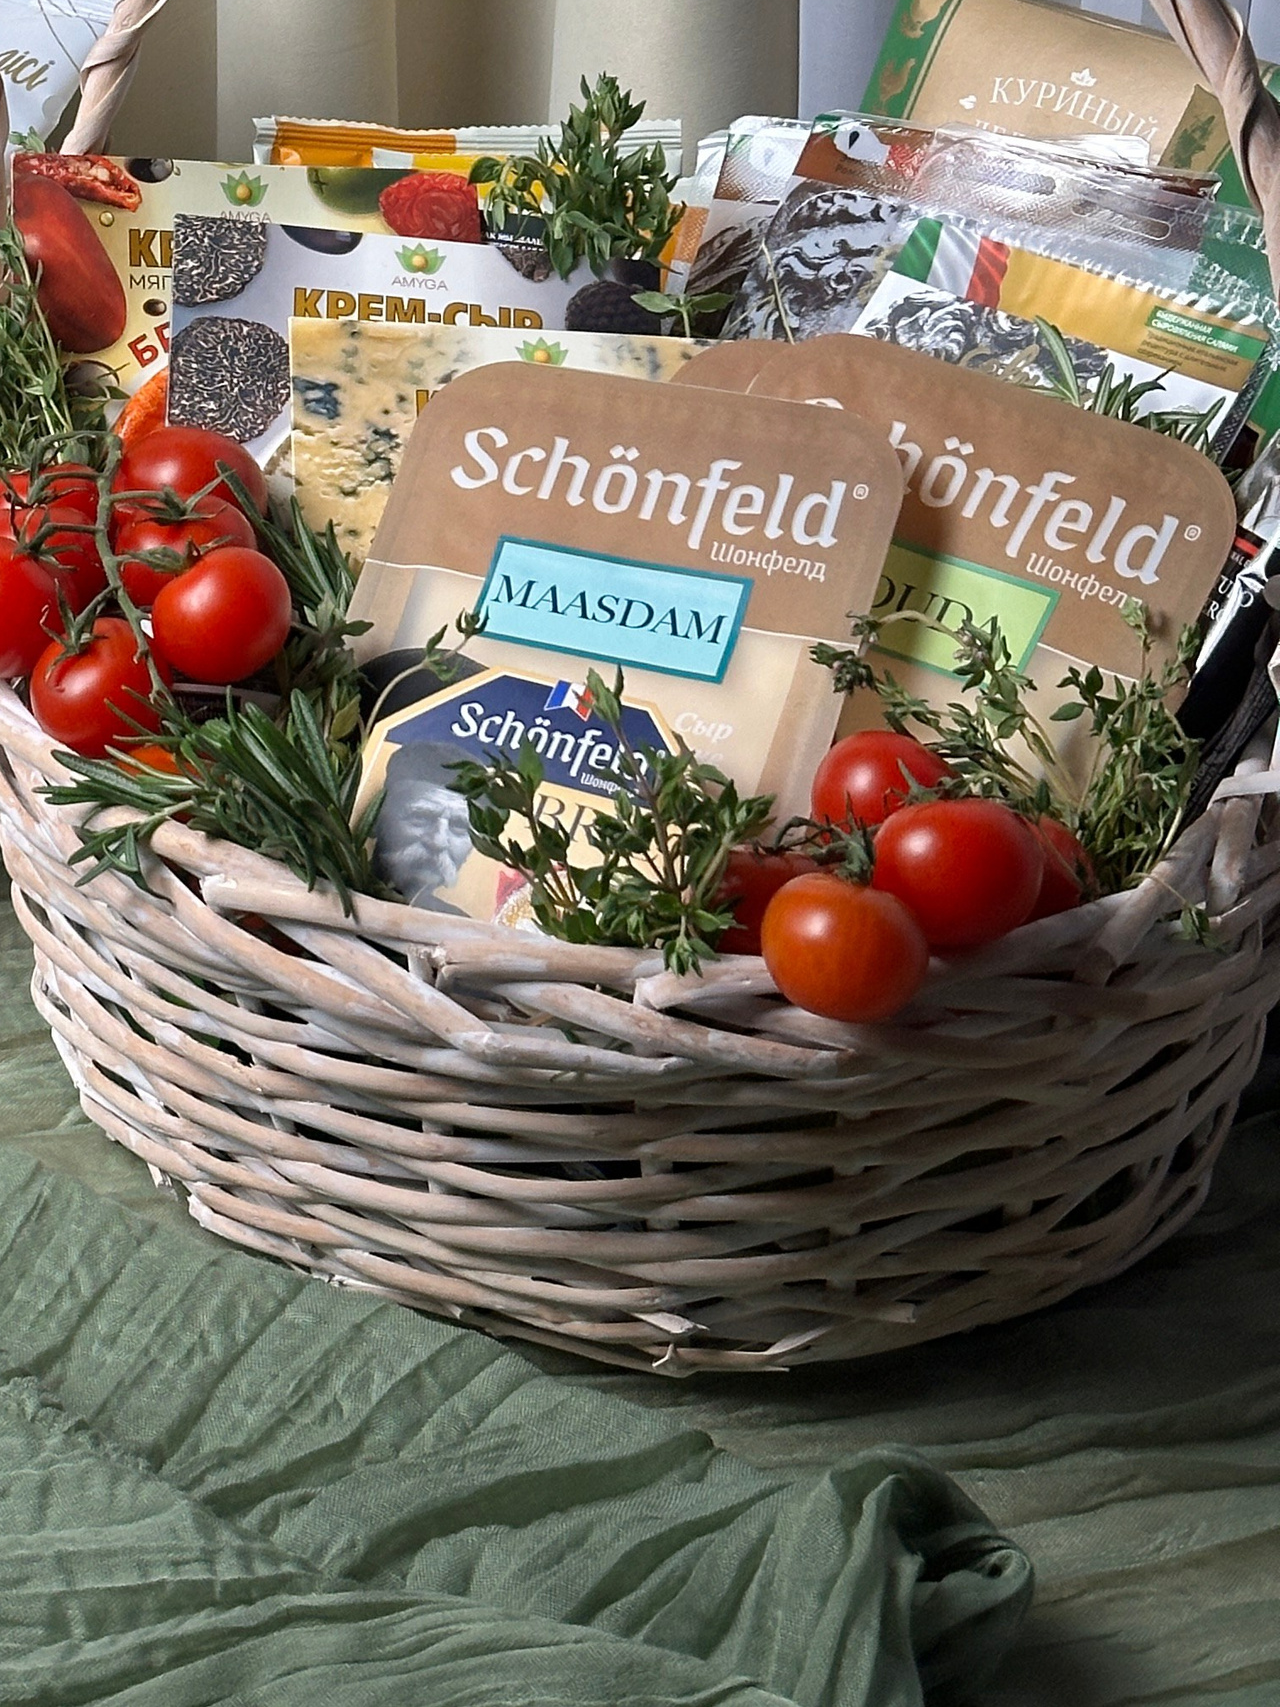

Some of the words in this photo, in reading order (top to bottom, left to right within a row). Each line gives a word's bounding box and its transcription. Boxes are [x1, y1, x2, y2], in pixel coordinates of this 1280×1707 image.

[989, 76, 1160, 143] КУРИНЫЙ
[129, 274, 172, 291] МЯГ
[391, 275, 448, 292] AMYGA
[293, 287, 544, 330] КРЕМ-СЫР
[450, 425, 848, 550] Schönfeld
[888, 420, 1180, 585] hönfeld
[710, 540, 827, 582] Шонфелд
[490, 572, 729, 645] MAASDAM
[675, 711, 734, 745] Сыр
